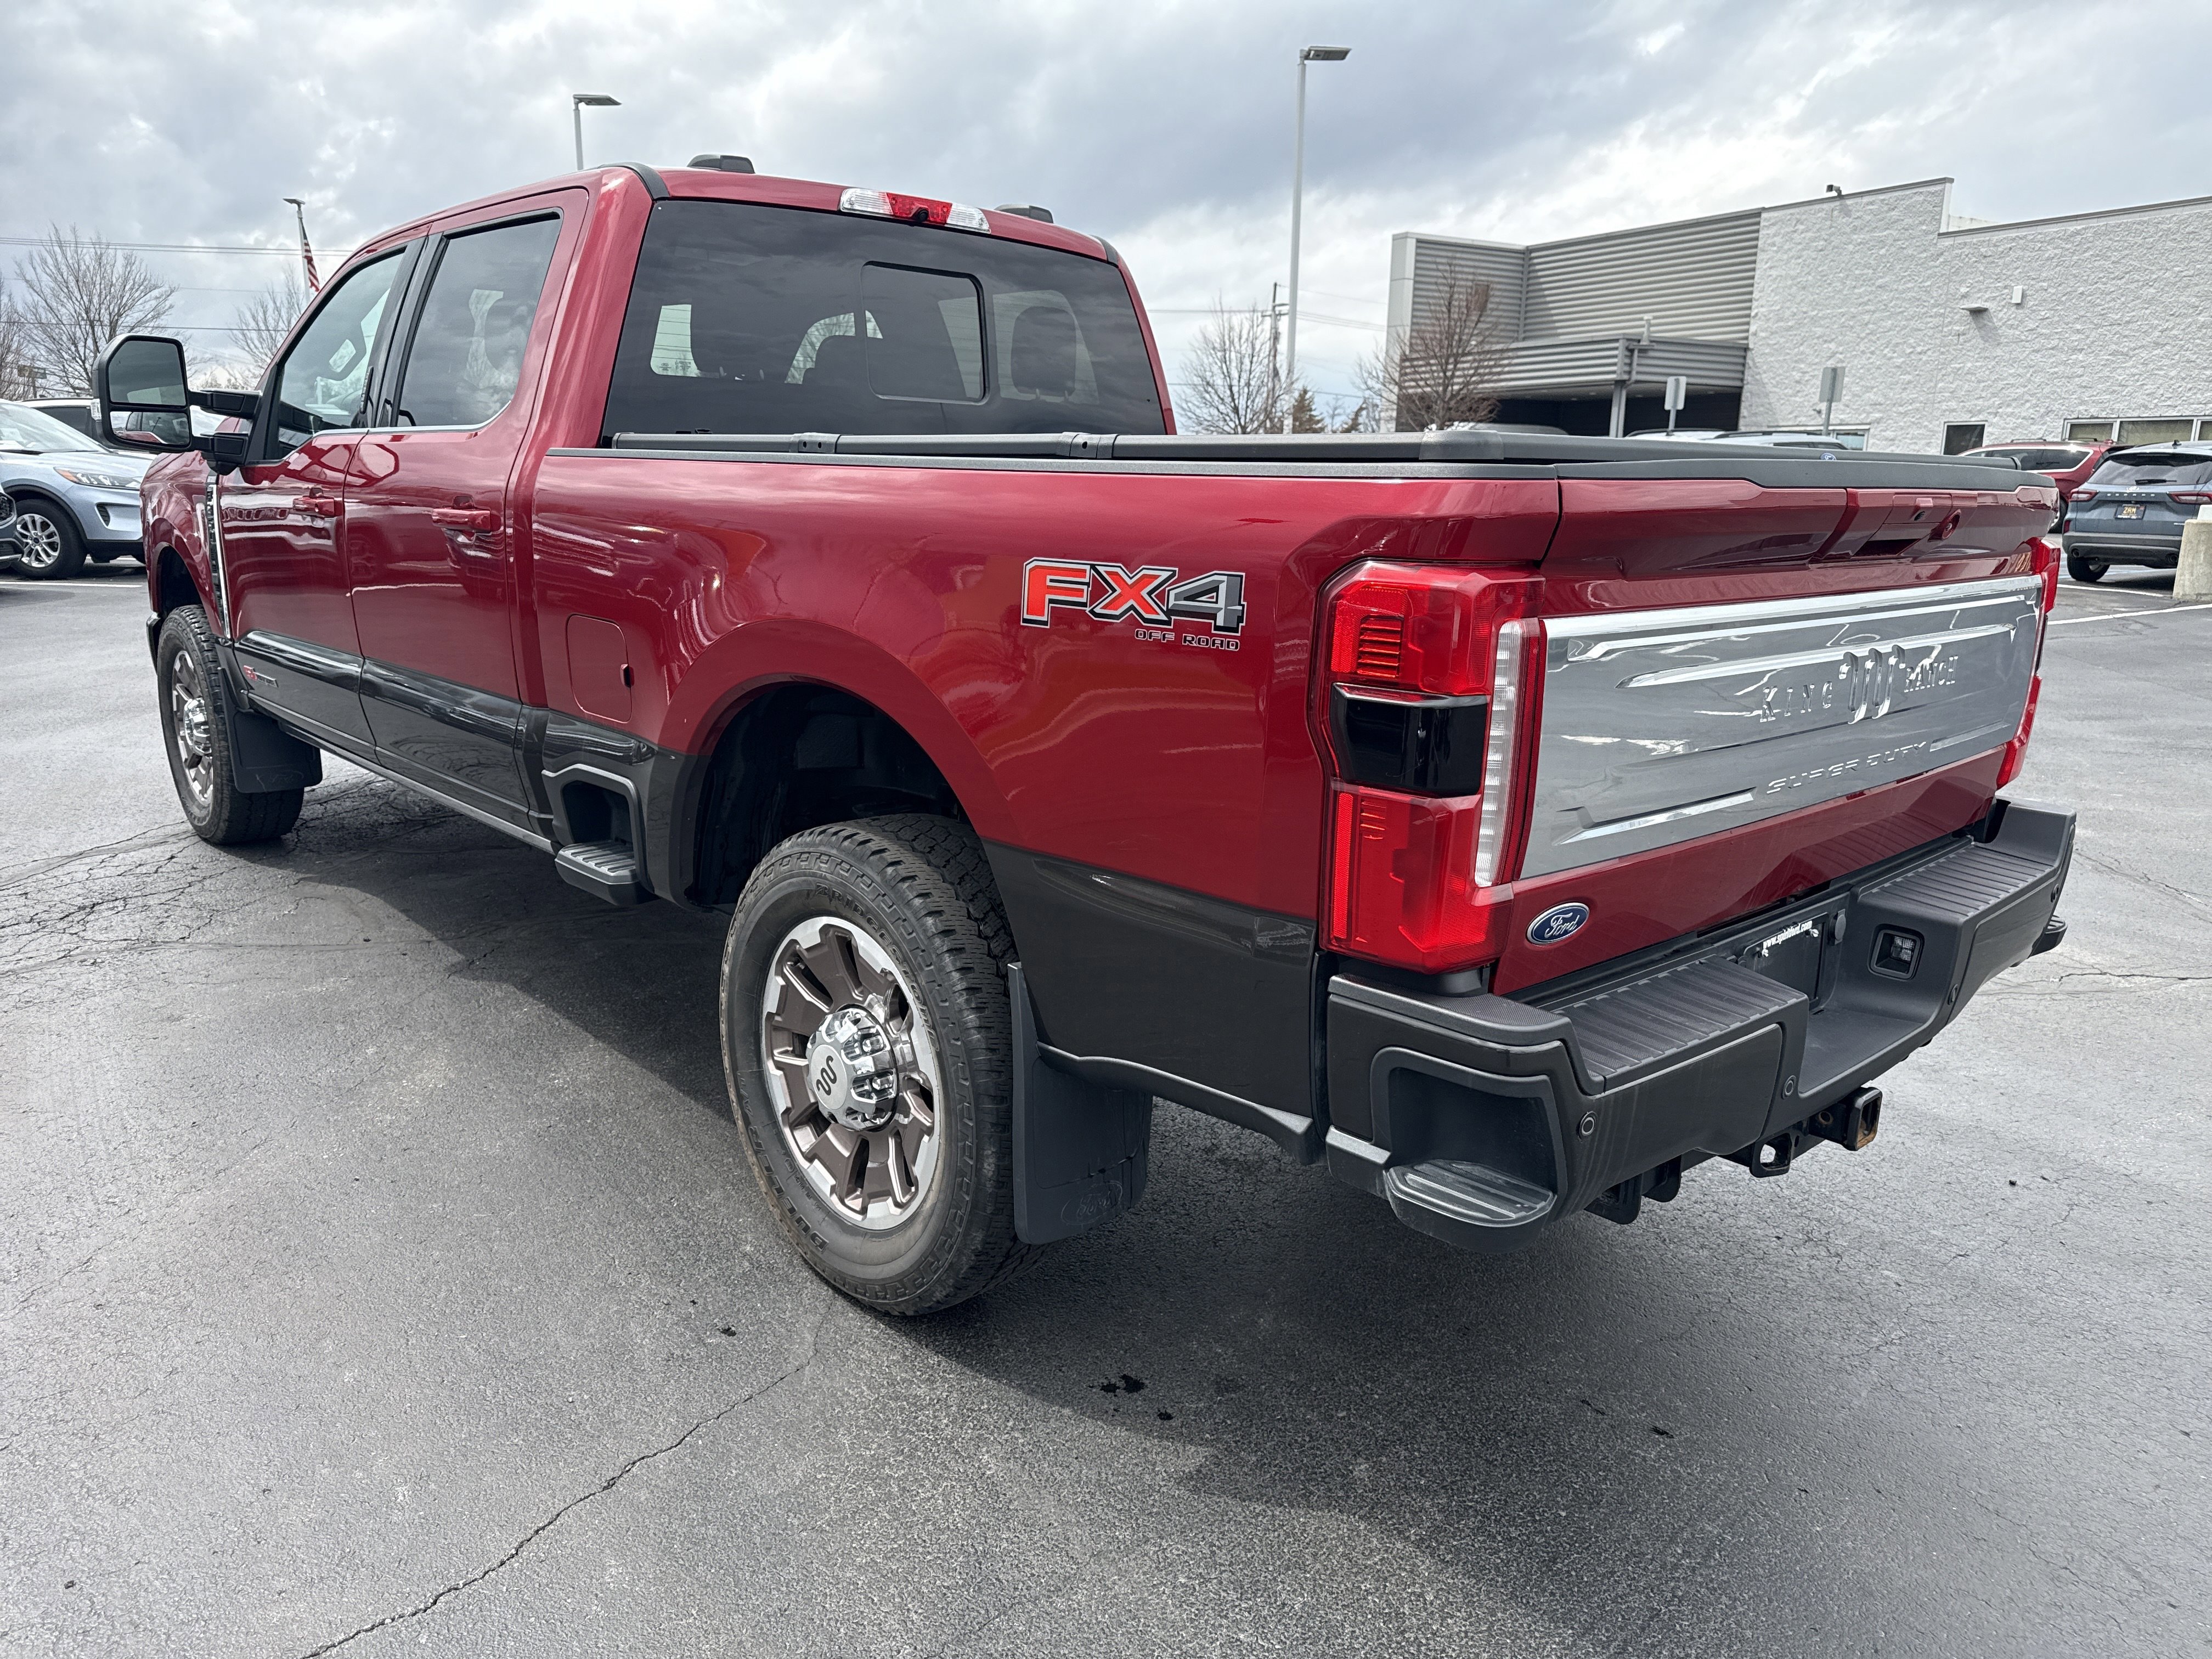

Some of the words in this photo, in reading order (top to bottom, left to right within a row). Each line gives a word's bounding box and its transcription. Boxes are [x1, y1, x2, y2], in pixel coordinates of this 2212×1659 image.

[1020, 557, 1246, 636] FX4
[1135, 629, 1176, 643] OFF
[1182, 634, 1240, 652] ROAD
[1759, 680, 1833, 723] KING
[1904, 654, 1959, 693] RANCH
[1766, 759, 1860, 794] SUPER
[1866, 741, 1927, 766] DUTY
[1544, 912, 1580, 939] Ford
[815, 883, 940, 1052] BRIDGESTONE
[748, 1126, 830, 1252] DUELER
